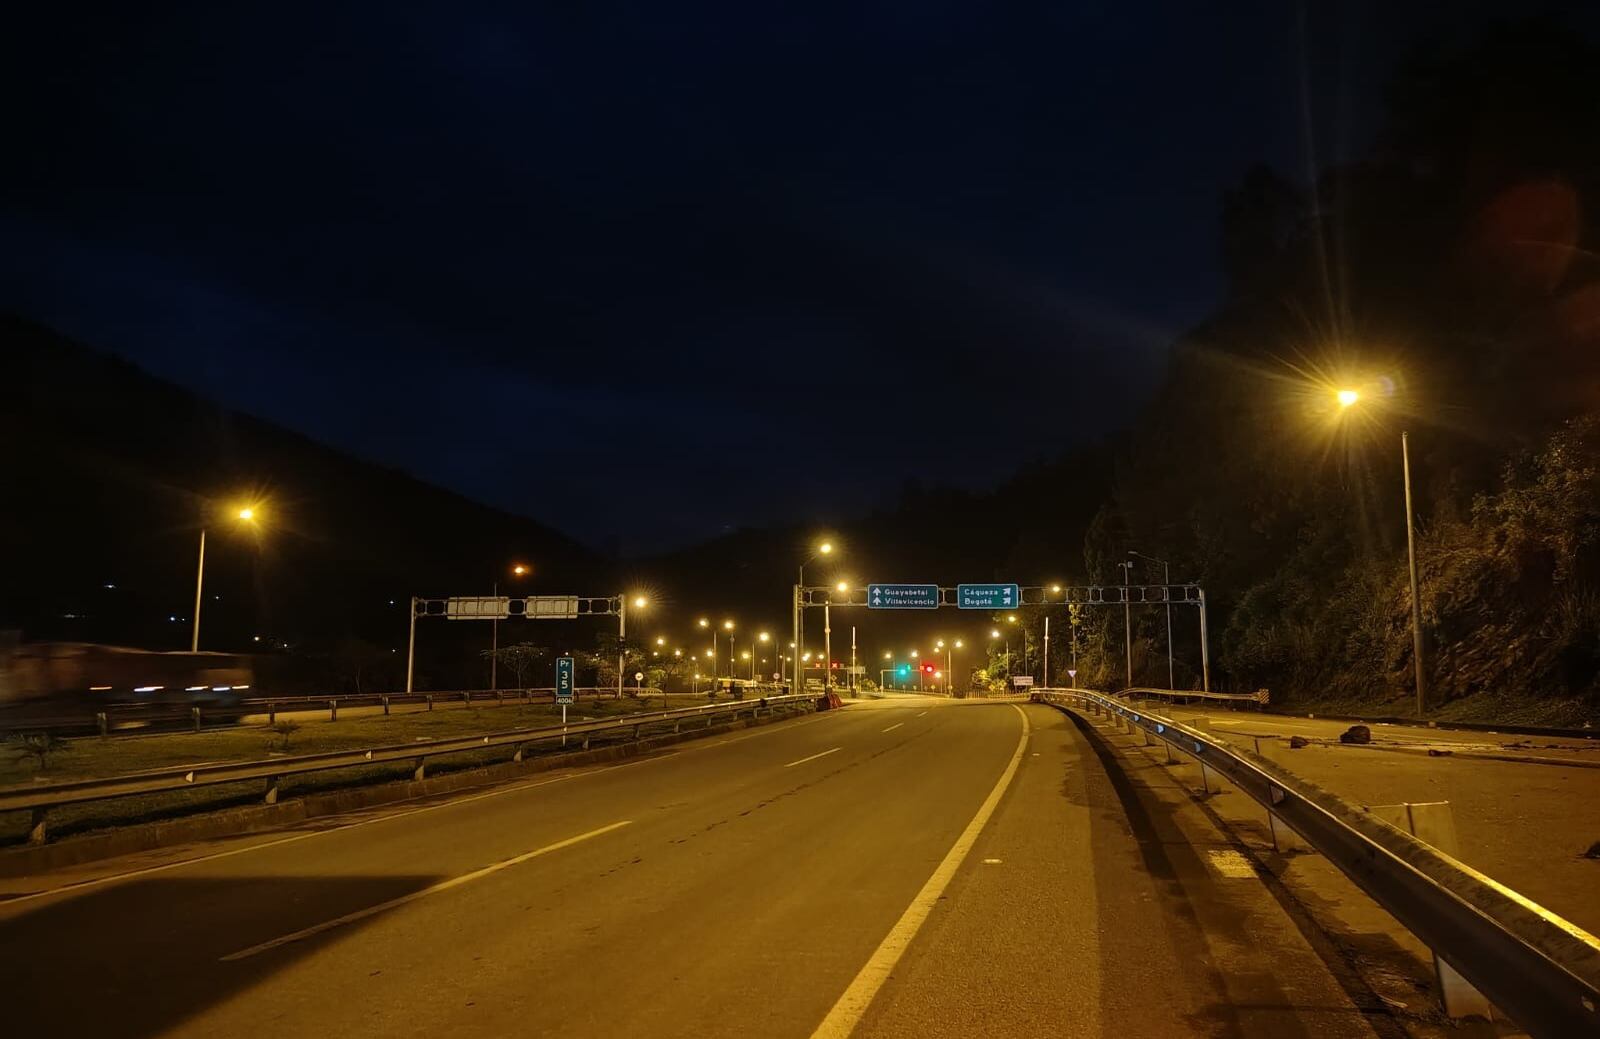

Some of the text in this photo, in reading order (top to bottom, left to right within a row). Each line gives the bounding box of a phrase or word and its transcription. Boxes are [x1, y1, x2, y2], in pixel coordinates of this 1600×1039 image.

[884, 588, 928, 597] Guayabetal
[885, 597, 935, 606] Villavicencio
[964, 597, 993, 607] Bogotá
